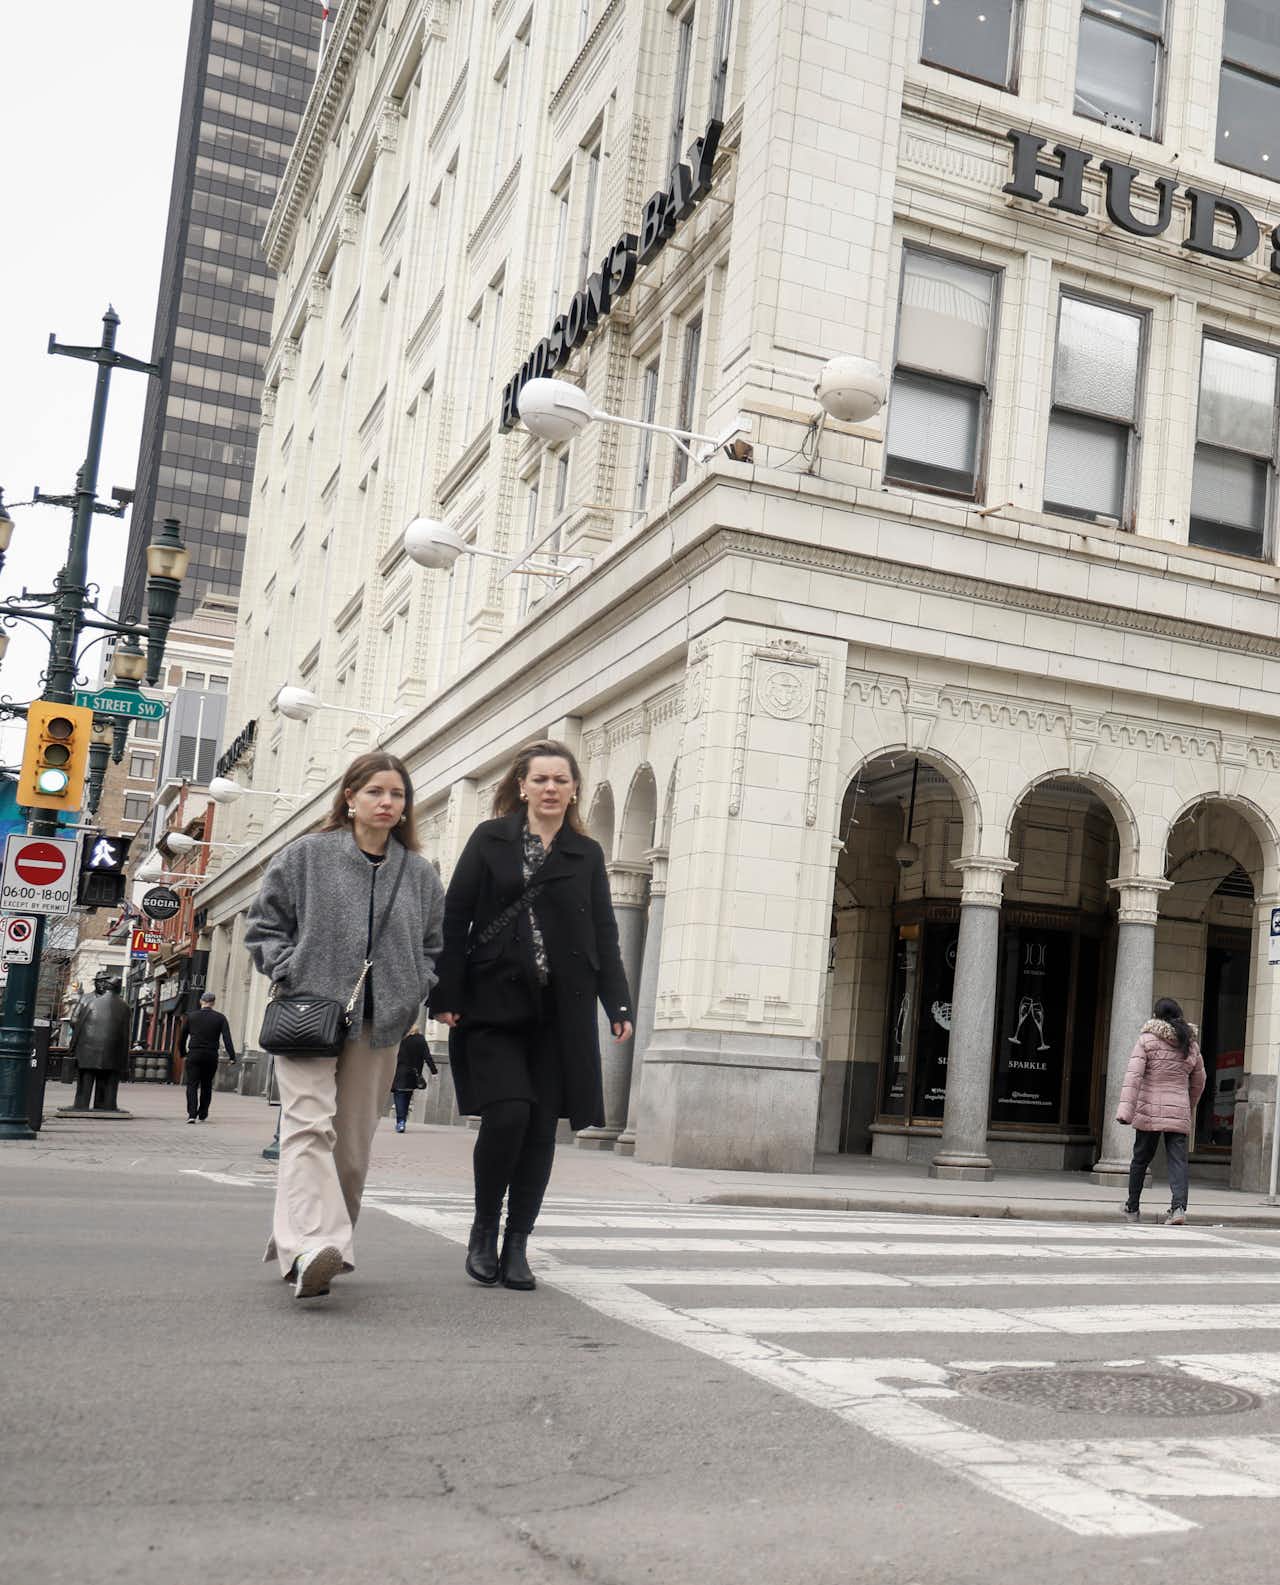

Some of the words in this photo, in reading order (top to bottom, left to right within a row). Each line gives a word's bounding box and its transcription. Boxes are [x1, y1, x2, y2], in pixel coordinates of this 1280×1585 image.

[637, 119, 724, 265] BAY
[82, 696, 88, 706] 1
[93, 697, 132, 713] STREET
[138, 703, 157, 715] SW
[144, 898, 180, 909] SOCIAL
[1008, 1060, 1047, 1071] SPARKLE
